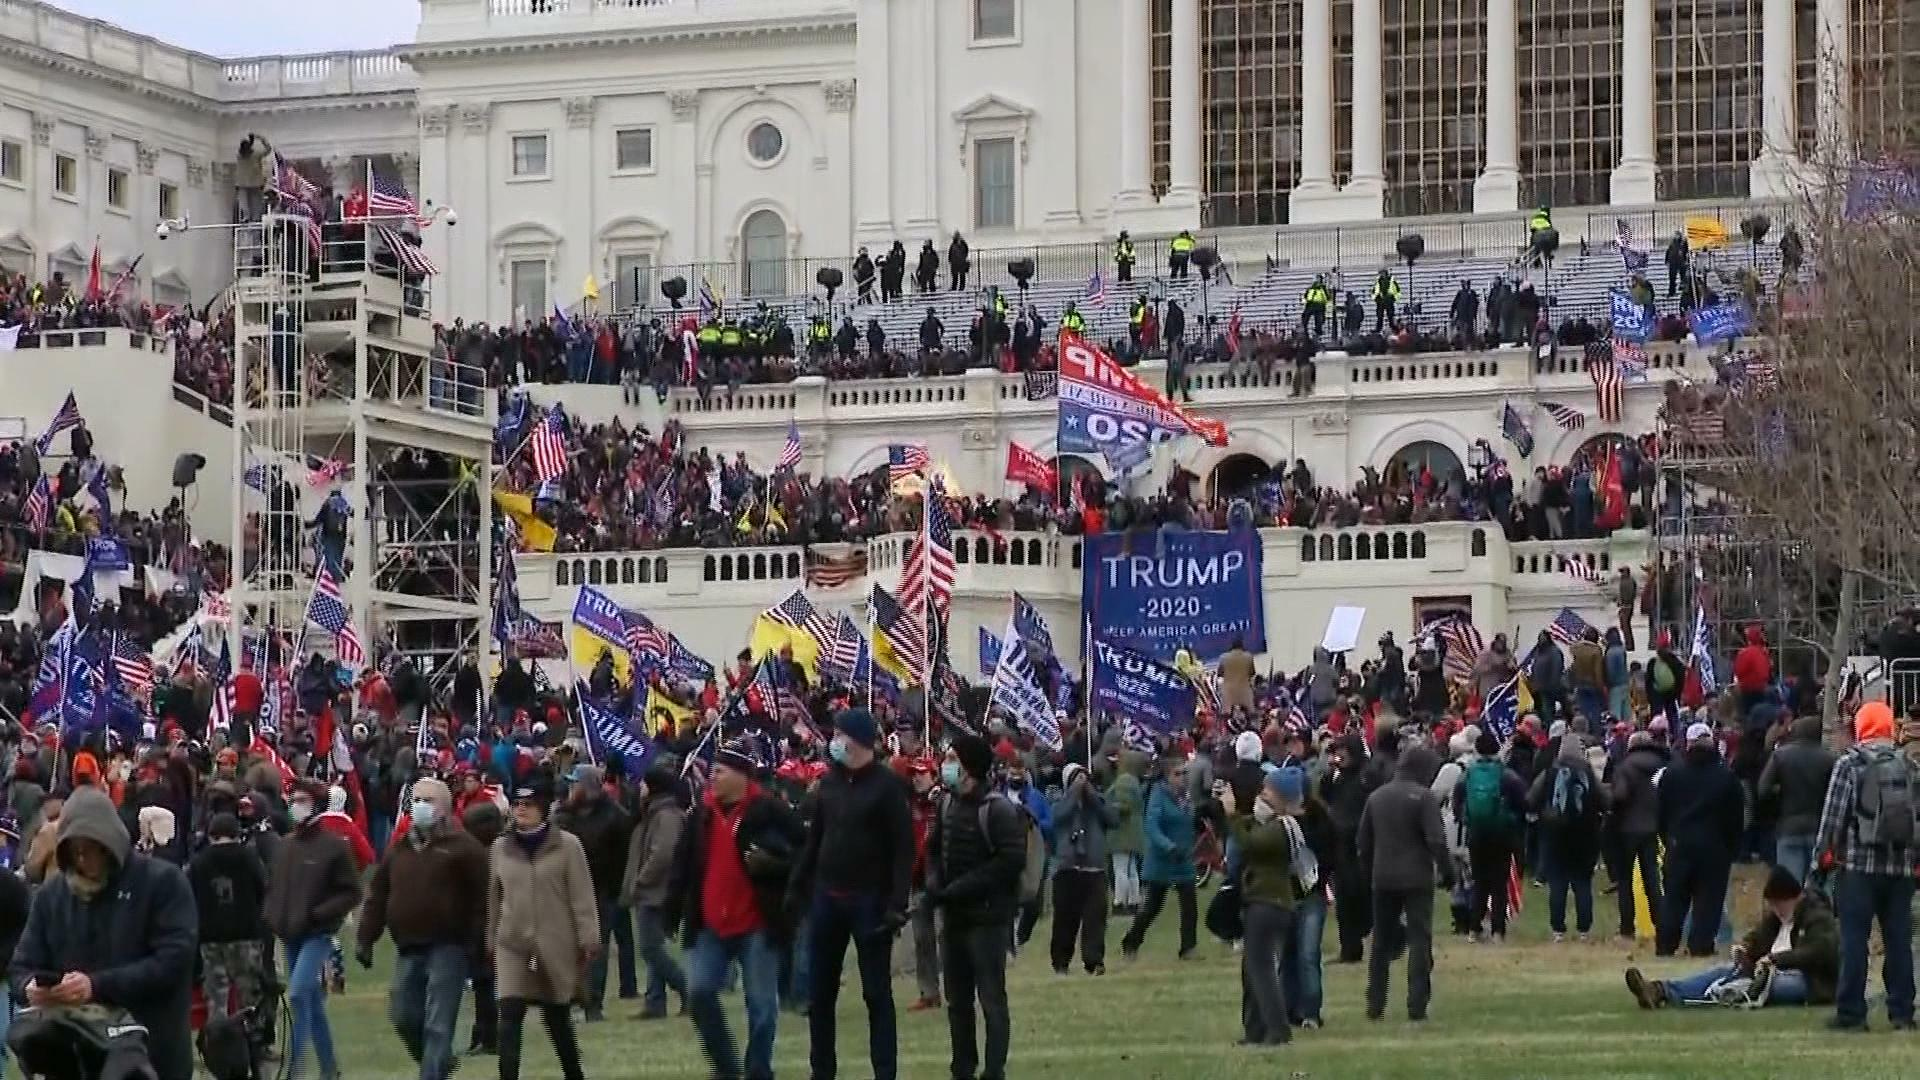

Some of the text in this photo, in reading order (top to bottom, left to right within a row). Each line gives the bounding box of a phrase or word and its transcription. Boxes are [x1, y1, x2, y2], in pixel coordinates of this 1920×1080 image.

[1102, 550, 1244, 589] TRUMP
[583, 589, 620, 619] TRU
[1139, 624, 1198, 638] AMERICA
